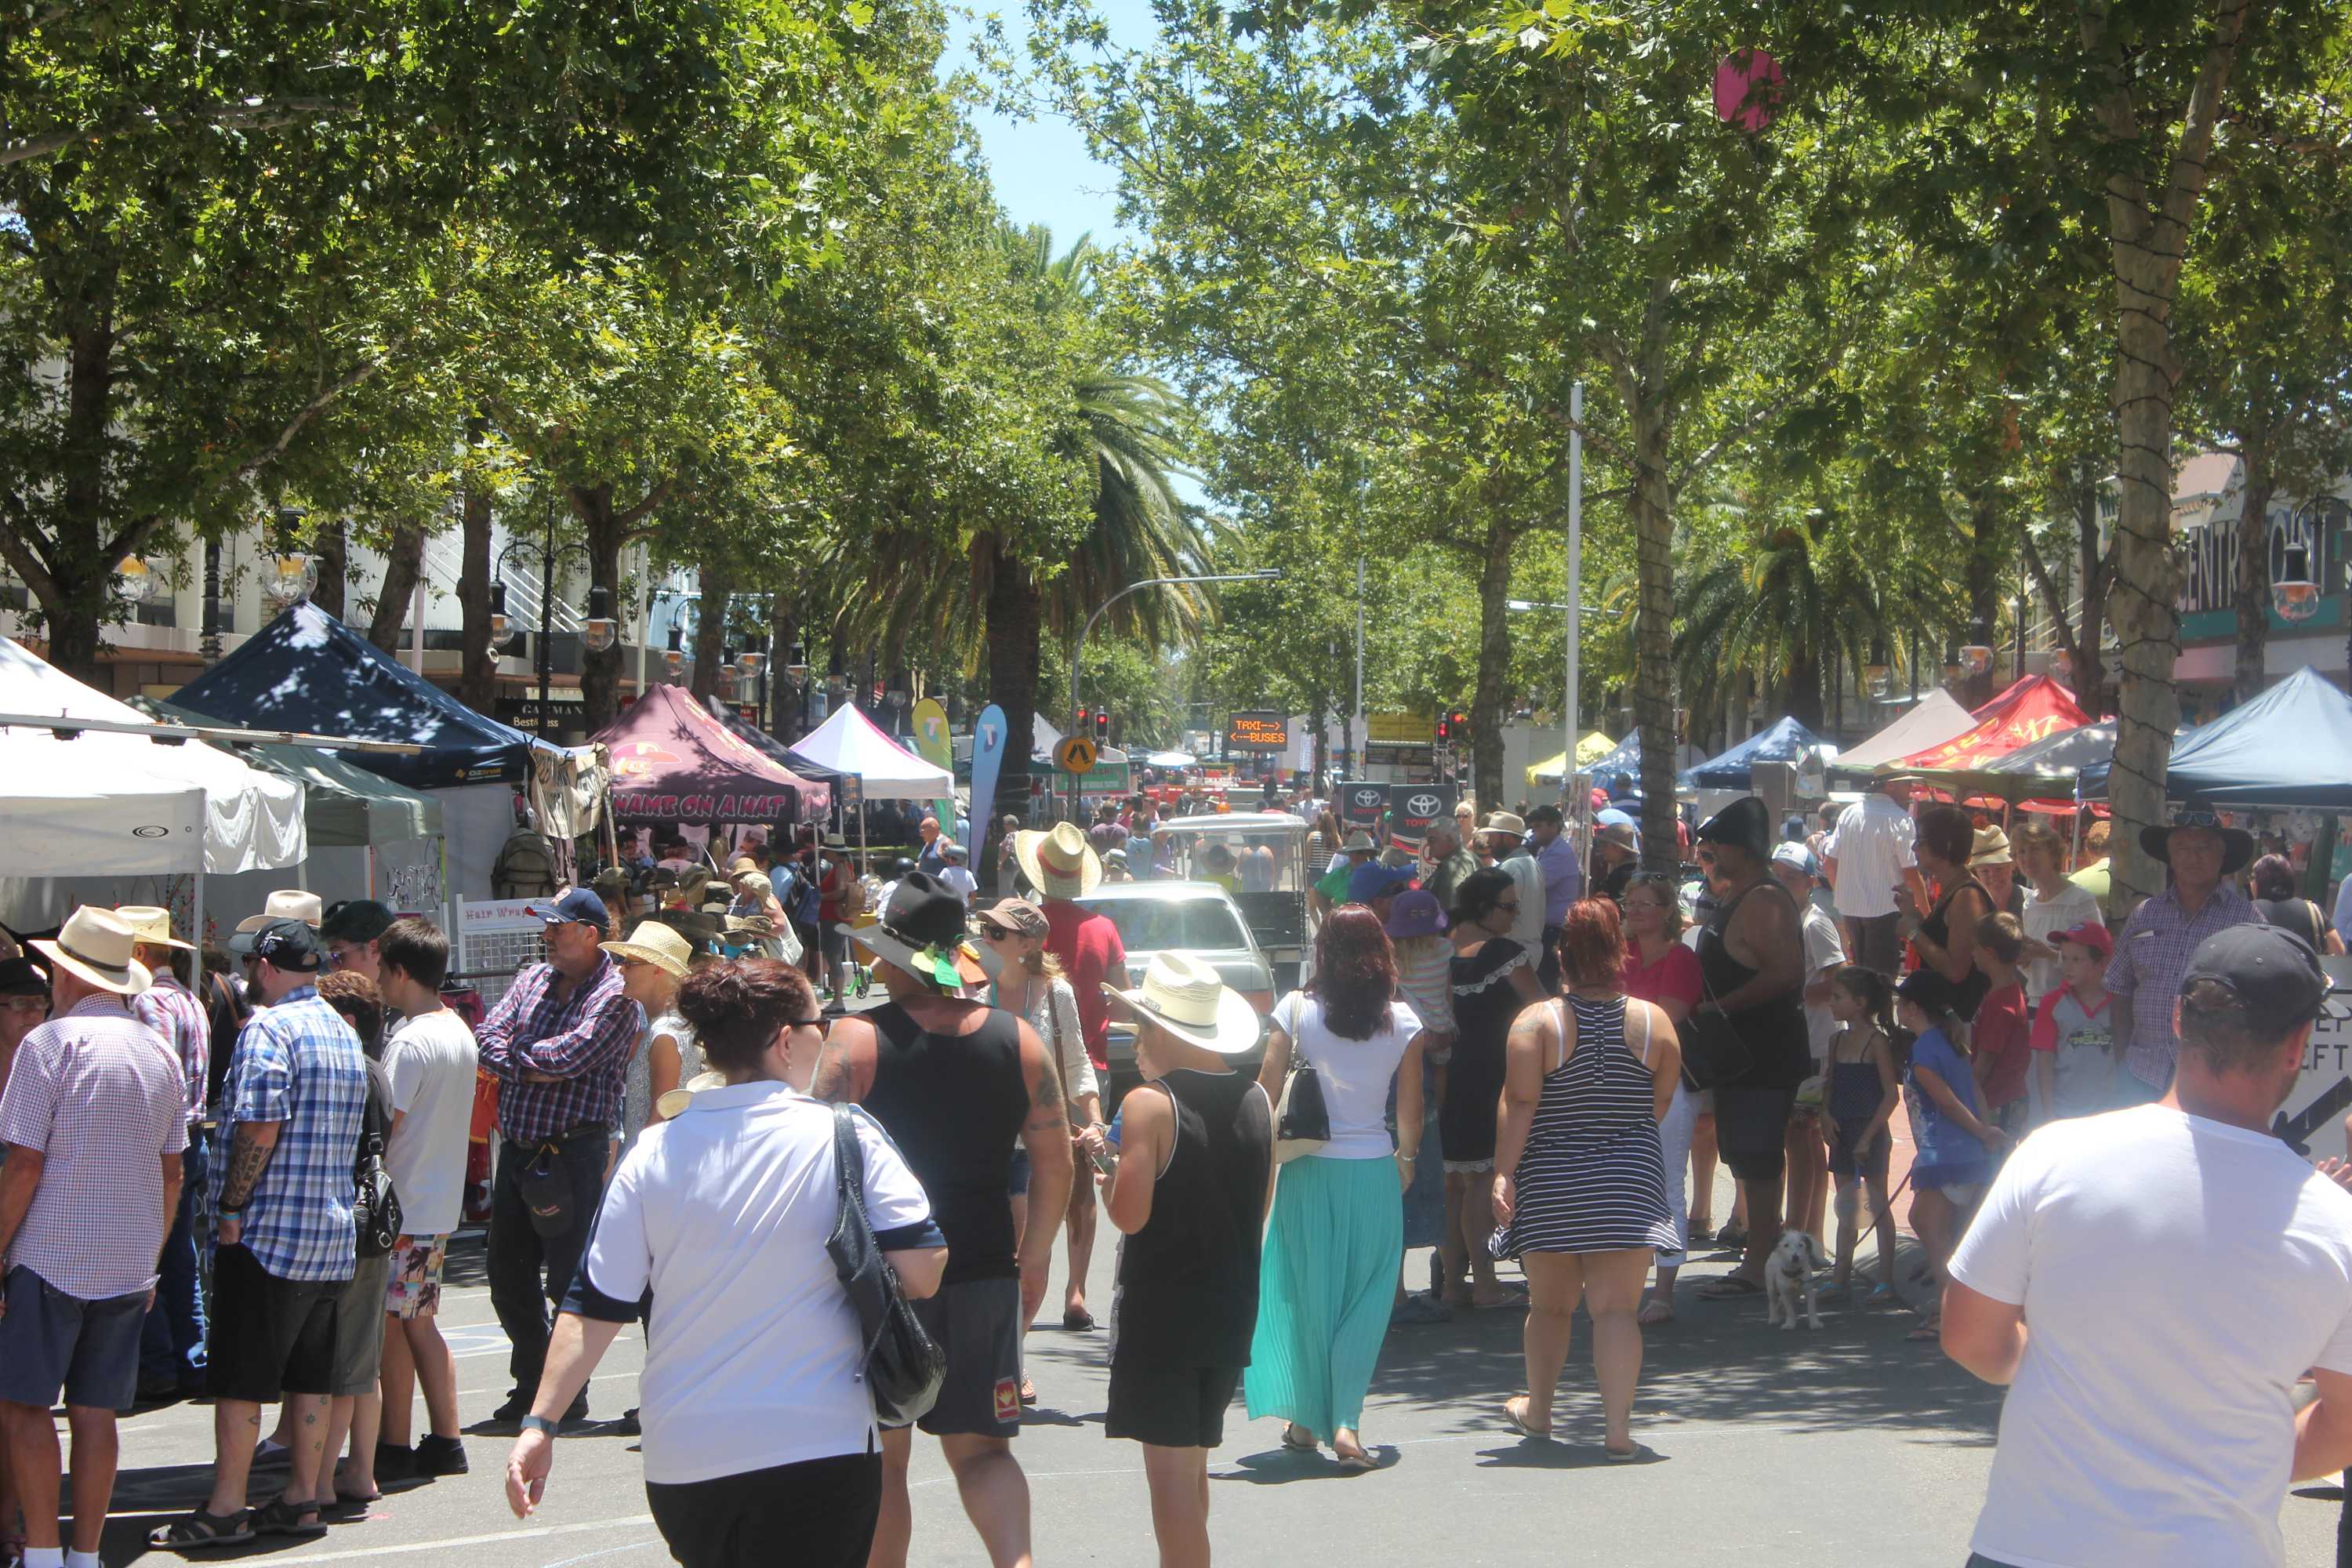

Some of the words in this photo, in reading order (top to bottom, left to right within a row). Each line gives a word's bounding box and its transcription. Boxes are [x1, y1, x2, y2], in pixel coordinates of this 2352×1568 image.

[521, 705, 584, 715] GAMAN
[514, 717, 559, 728] Best&ess
[1236, 720, 1261, 731] TAXI
[1250, 732, 1286, 743] BUSES
[612, 793, 678, 818] NAME
[680, 794, 715, 818] ON
[717, 794, 736, 818] A
[738, 794, 786, 818] HAT
[1404, 818, 1431, 827] TOYO
